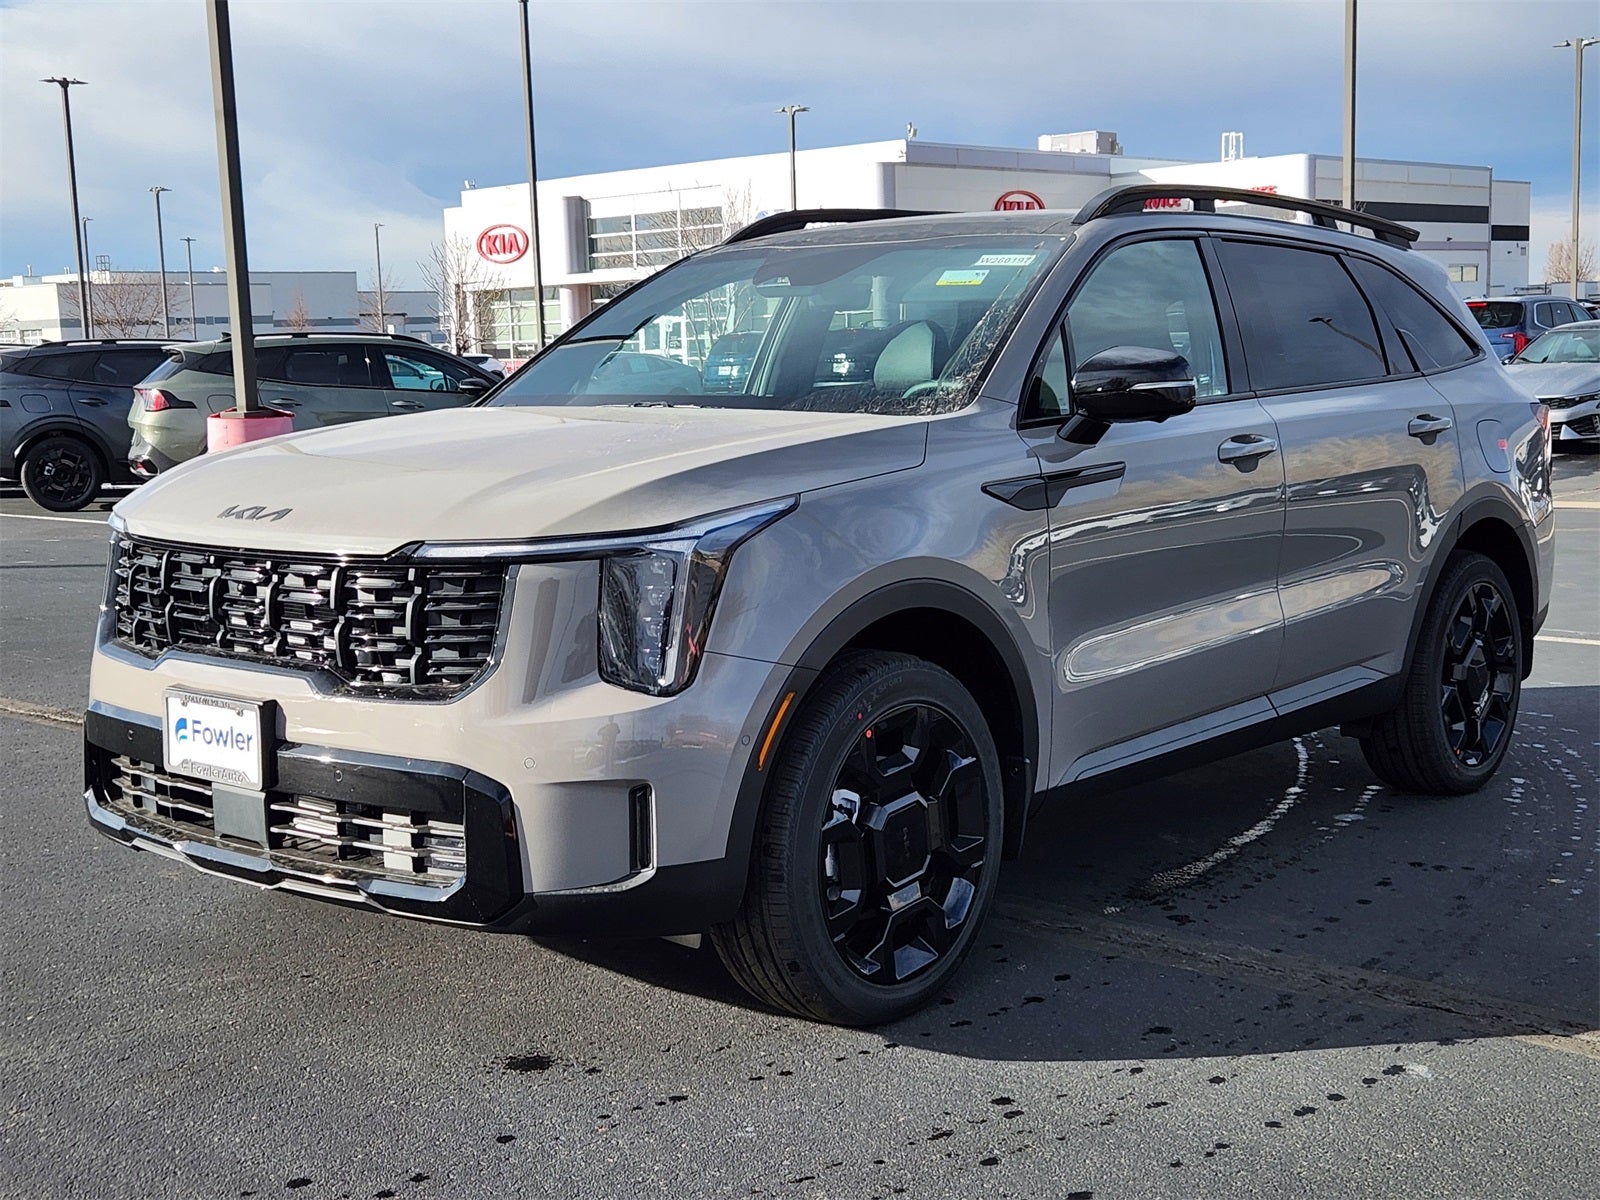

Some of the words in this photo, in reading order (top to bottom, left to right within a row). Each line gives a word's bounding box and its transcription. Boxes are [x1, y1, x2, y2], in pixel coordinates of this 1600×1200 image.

[483, 232, 521, 256] KIA
[217, 504, 293, 522] KIA
[191, 720, 253, 752] Fowler
